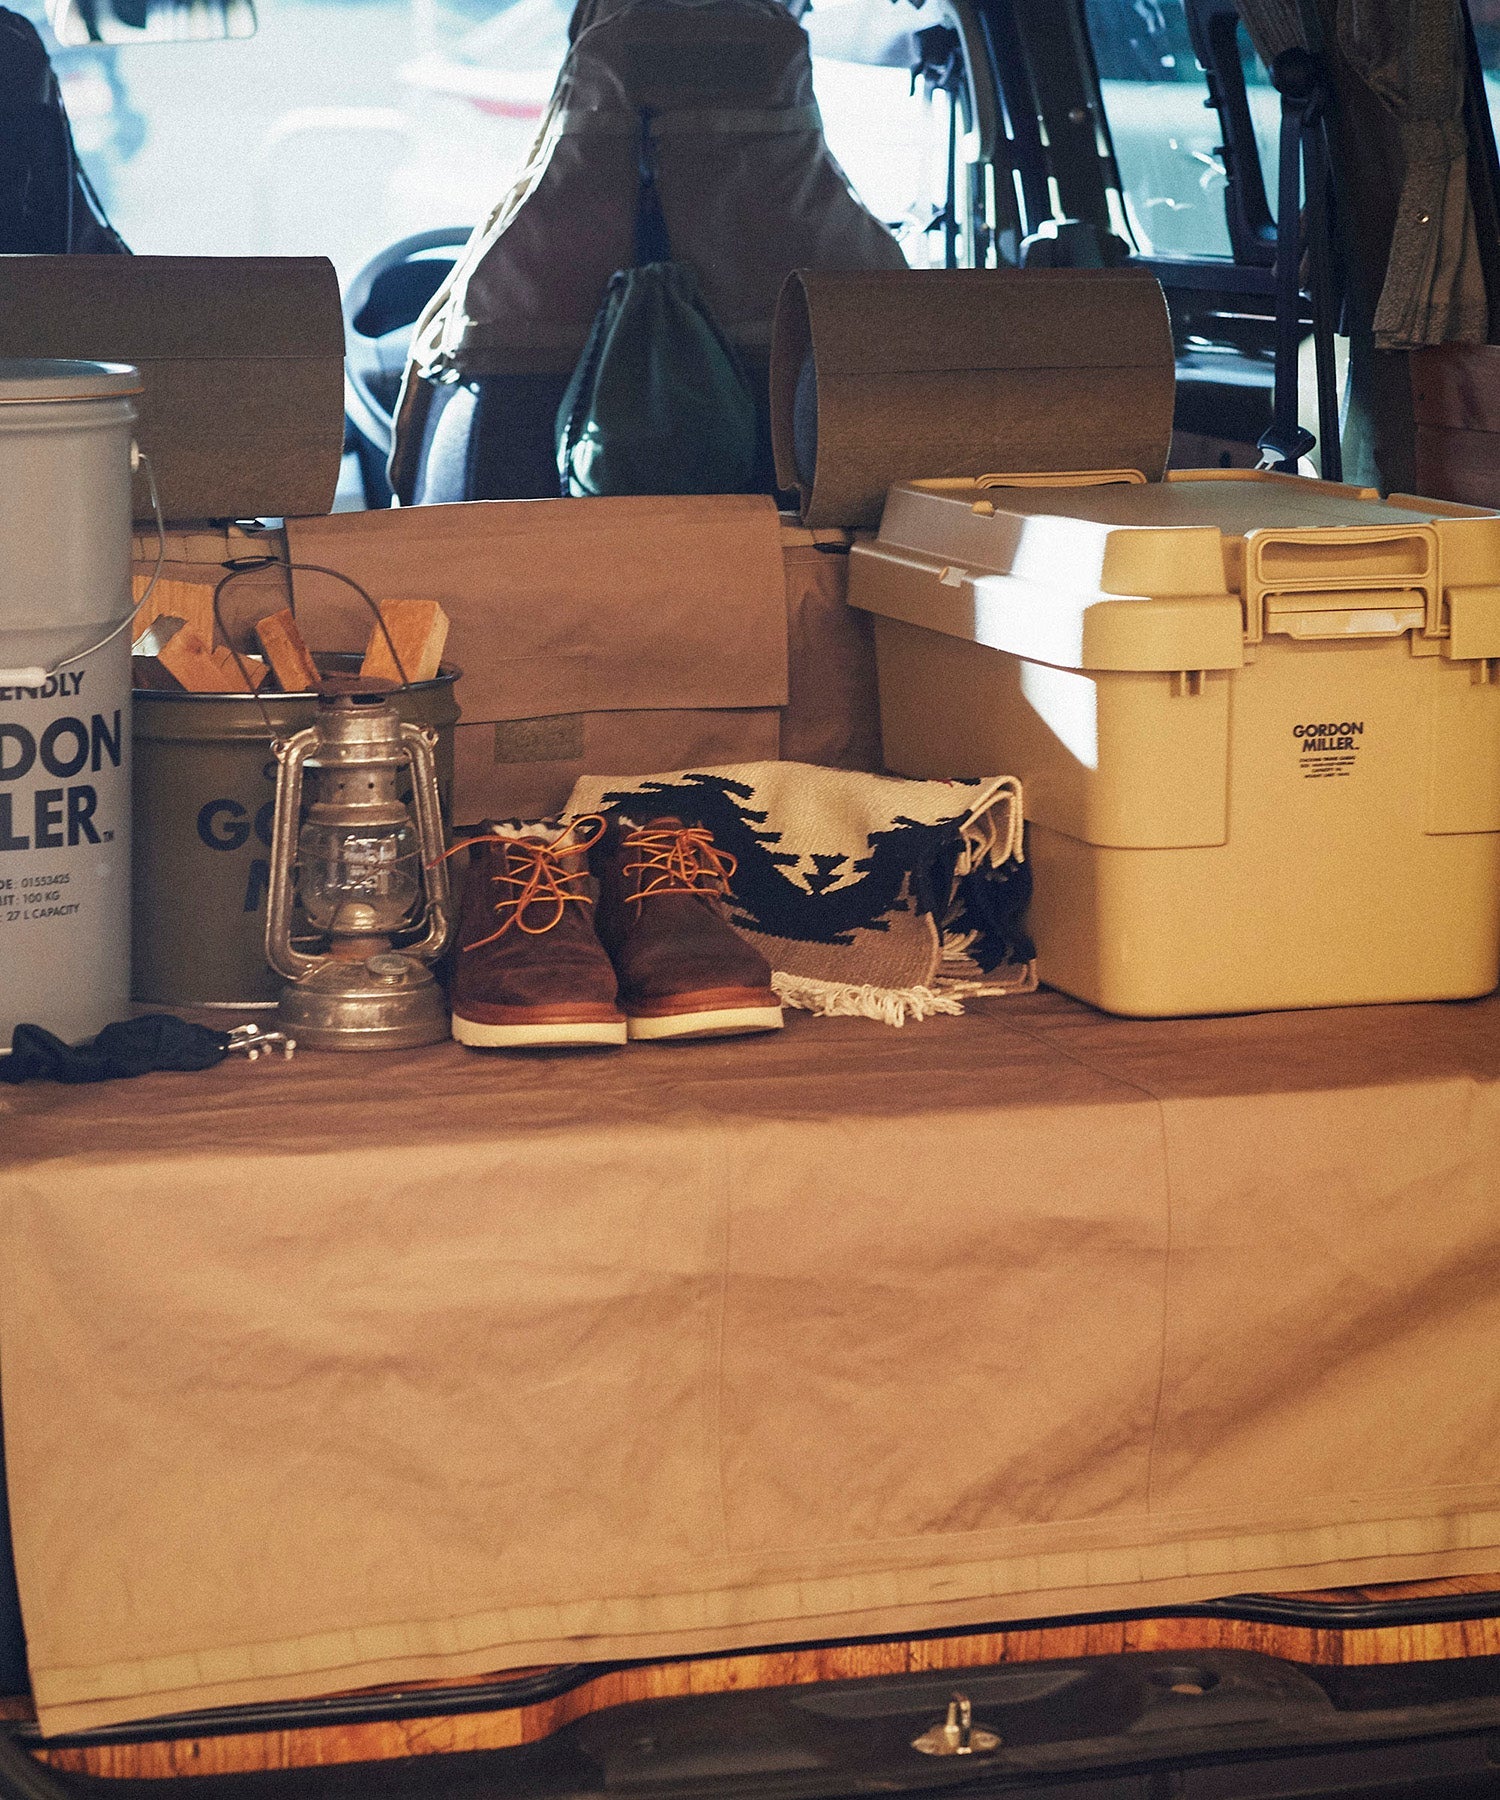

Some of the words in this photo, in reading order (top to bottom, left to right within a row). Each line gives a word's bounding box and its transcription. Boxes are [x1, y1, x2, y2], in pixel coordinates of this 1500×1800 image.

[1293, 722, 1363, 738] GORDON
[0, 710, 121, 781] DON
[23, 893, 42, 903] 100
[45, 891, 60, 901] KG
[7, 911, 21, 921] 27
[32, 903, 80, 919] CAPACITY
